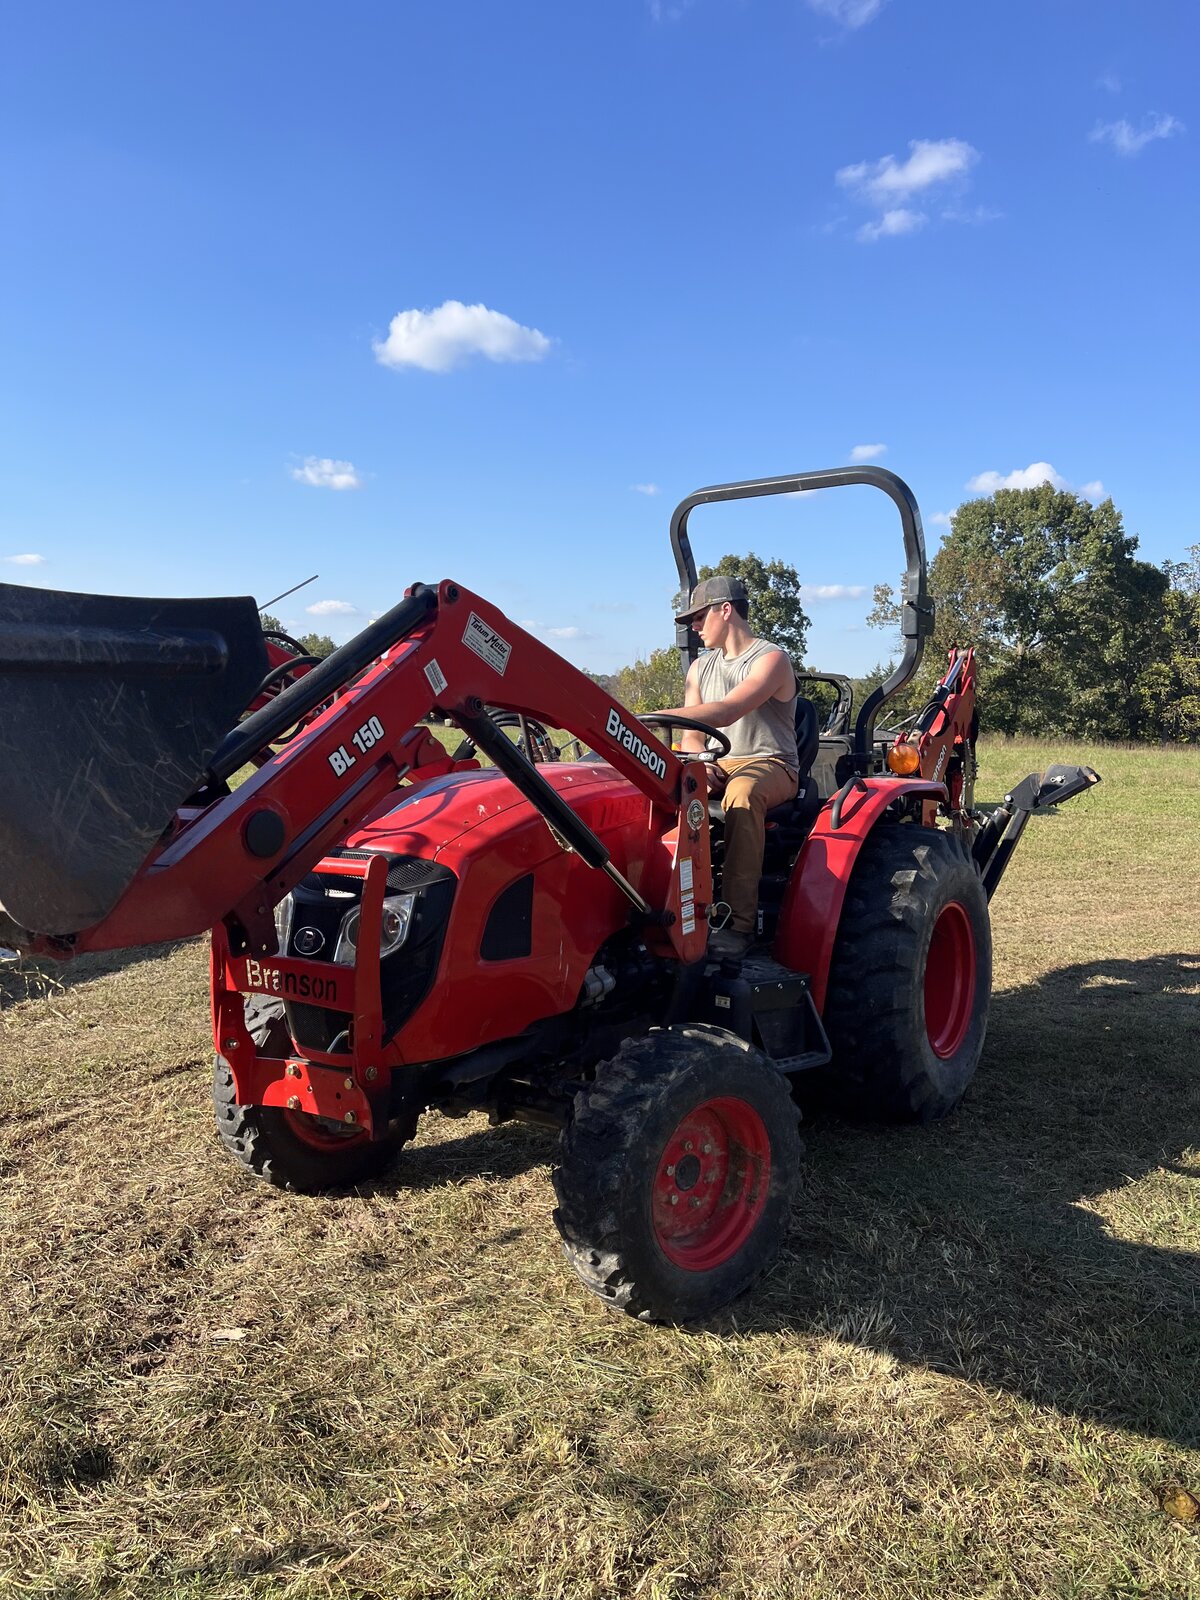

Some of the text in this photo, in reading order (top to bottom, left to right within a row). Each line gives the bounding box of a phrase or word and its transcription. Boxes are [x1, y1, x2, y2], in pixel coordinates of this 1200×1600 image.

[471, 617, 489, 638] Tatum
[484, 635, 507, 654] Motor
[328, 715, 385, 777] BL 150
[605, 707, 667, 779] Branson
[931, 744, 947, 782] anson
[246, 959, 337, 1002] Branson
